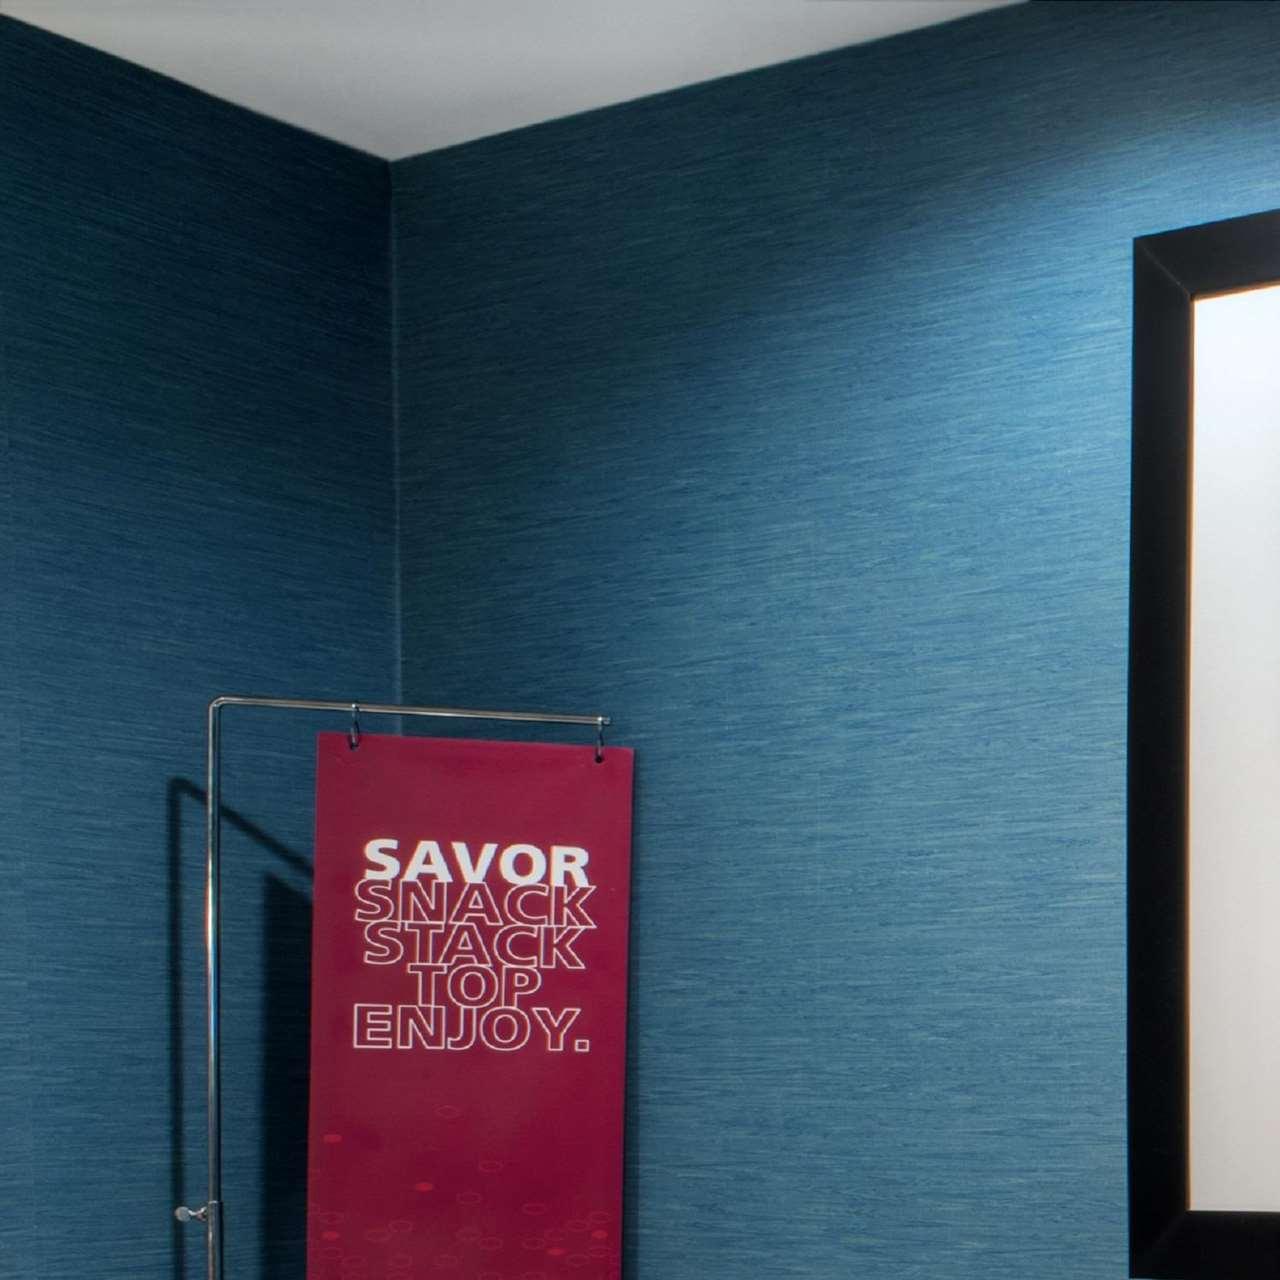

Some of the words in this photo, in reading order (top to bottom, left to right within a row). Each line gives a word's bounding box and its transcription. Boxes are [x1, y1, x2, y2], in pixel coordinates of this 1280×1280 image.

[363, 838, 590, 888] SAVOR
[354, 878, 597, 928] SNACK
[363, 920, 586, 969] STACK
[407, 962, 542, 1009] TOP
[353, 1003, 590, 1052] ENJOY.
